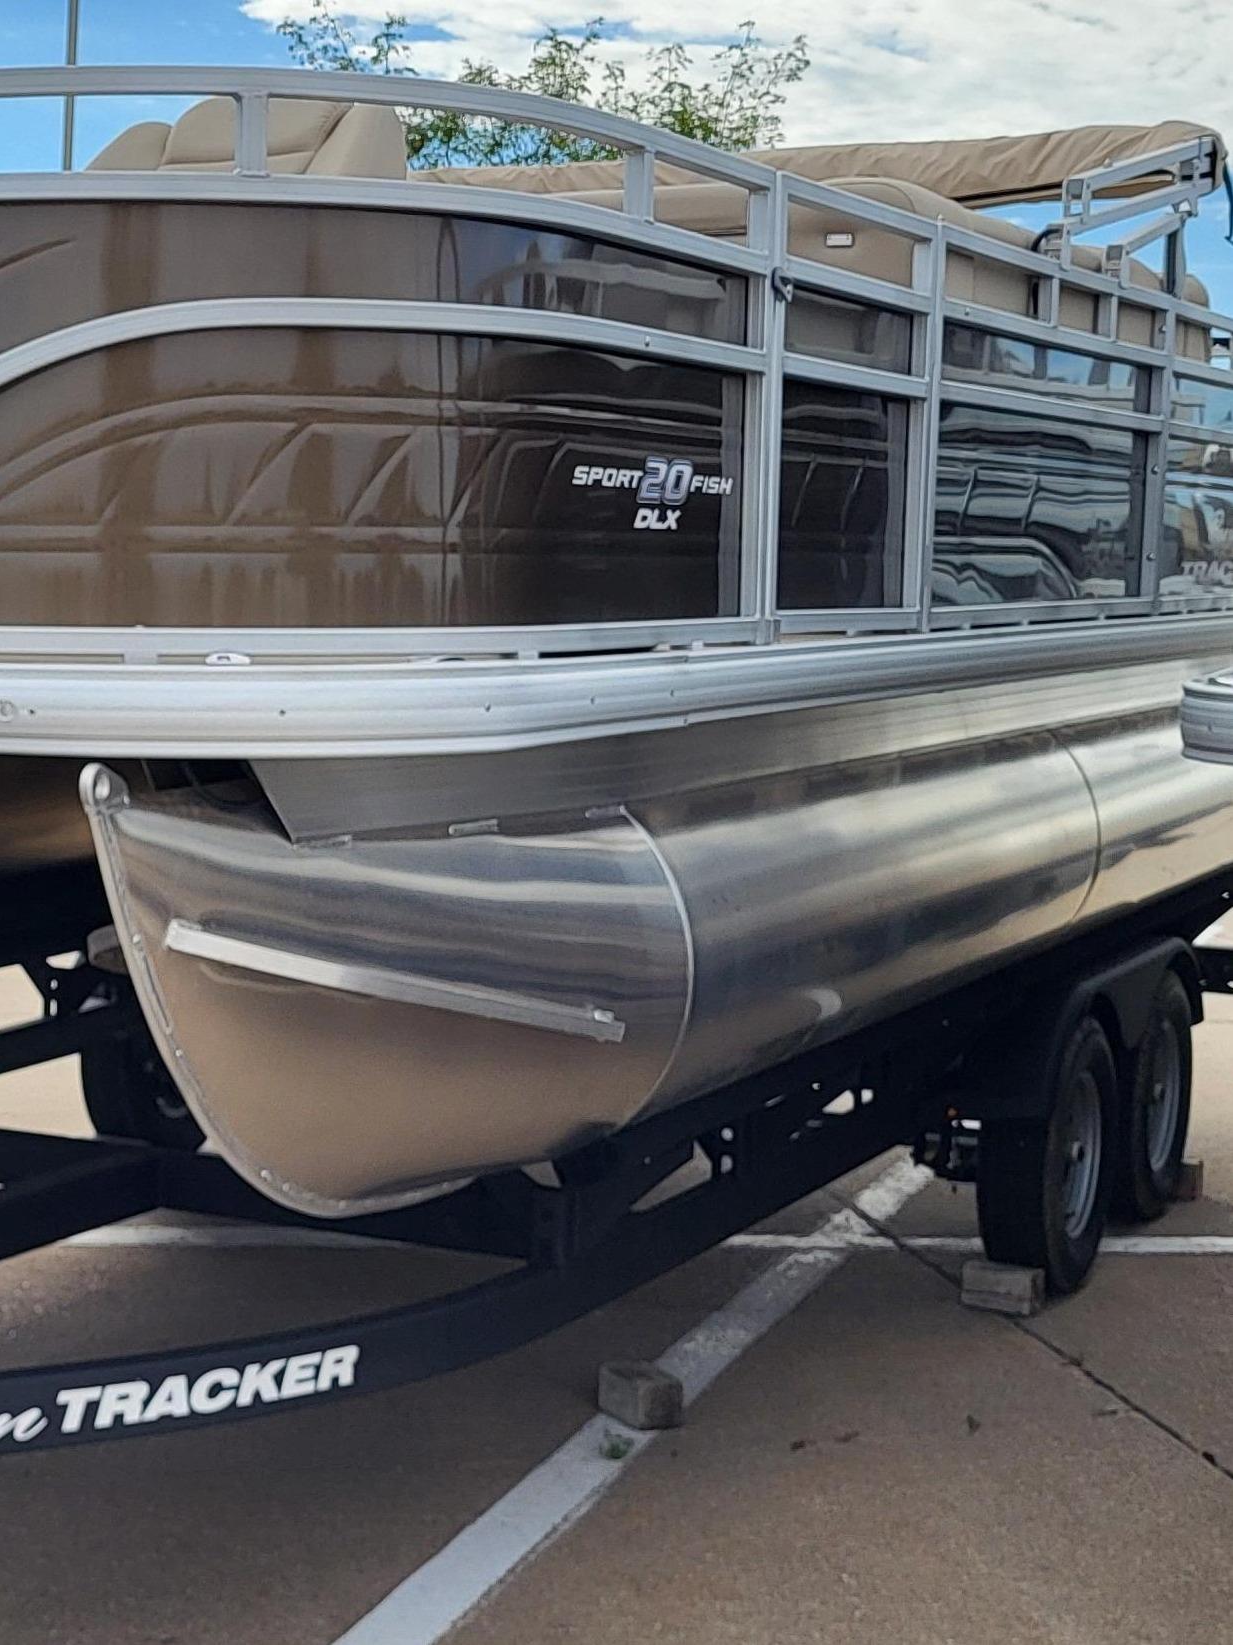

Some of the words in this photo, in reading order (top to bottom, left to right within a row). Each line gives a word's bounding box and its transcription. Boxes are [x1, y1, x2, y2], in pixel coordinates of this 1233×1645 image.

[572, 465, 643, 488] SPORT
[636, 455, 694, 506] 20
[689, 475, 734, 496] FISH
[633, 507, 682, 530] DLX
[55, 1344, 361, 1434] TRACKER
